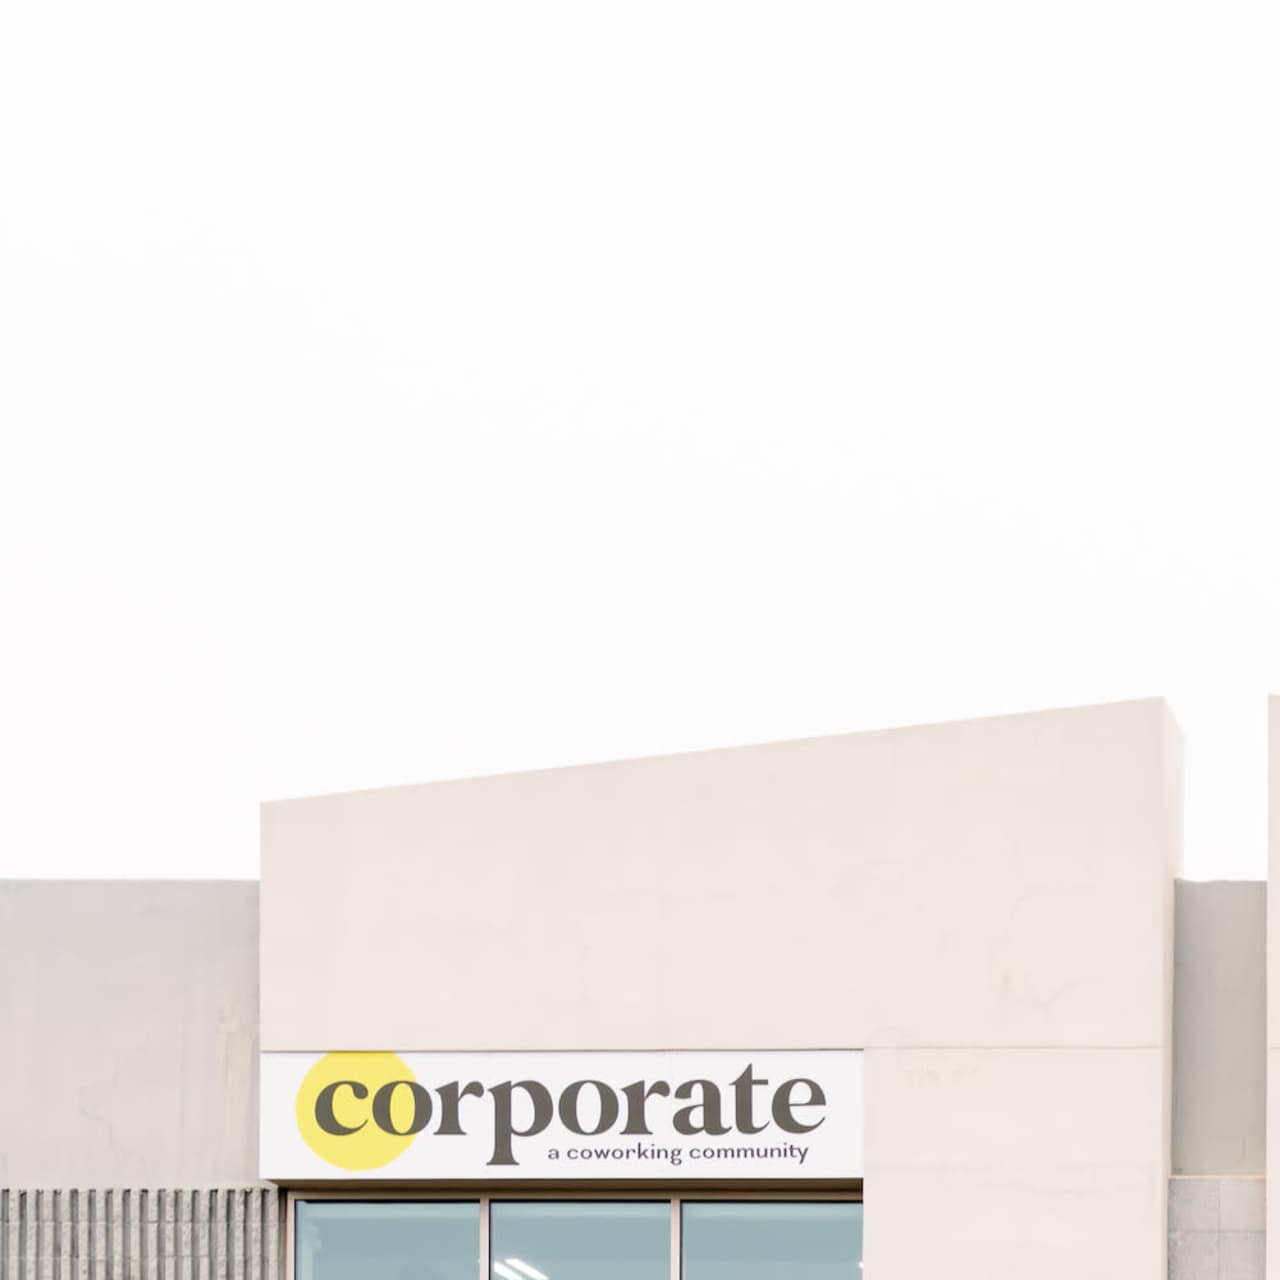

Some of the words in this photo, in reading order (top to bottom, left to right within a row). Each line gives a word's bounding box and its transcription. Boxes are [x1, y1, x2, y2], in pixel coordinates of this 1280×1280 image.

[315, 1064, 827, 1166] corporate
[548, 1148, 560, 1160] a
[566, 1142, 683, 1166] coworking
[688, 1142, 809, 1165] community
